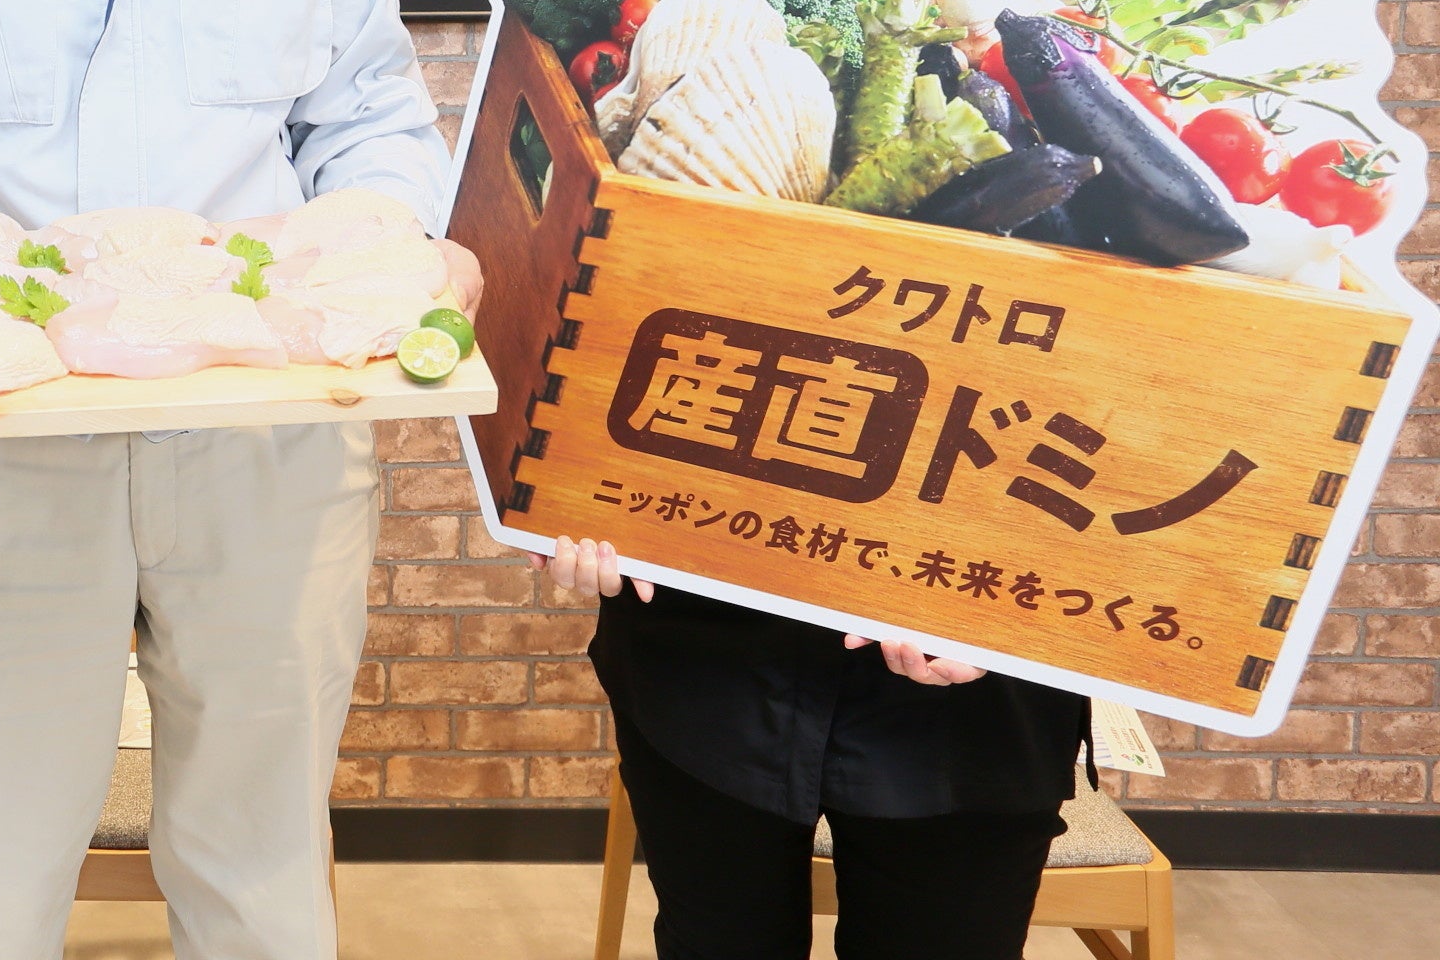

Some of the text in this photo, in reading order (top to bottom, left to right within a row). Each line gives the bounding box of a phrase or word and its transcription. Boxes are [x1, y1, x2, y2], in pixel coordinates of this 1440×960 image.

[827, 265, 1066, 353] クワトロ
[593, 479, 1205, 651] ニッポンの食材で、未来をつくる。
